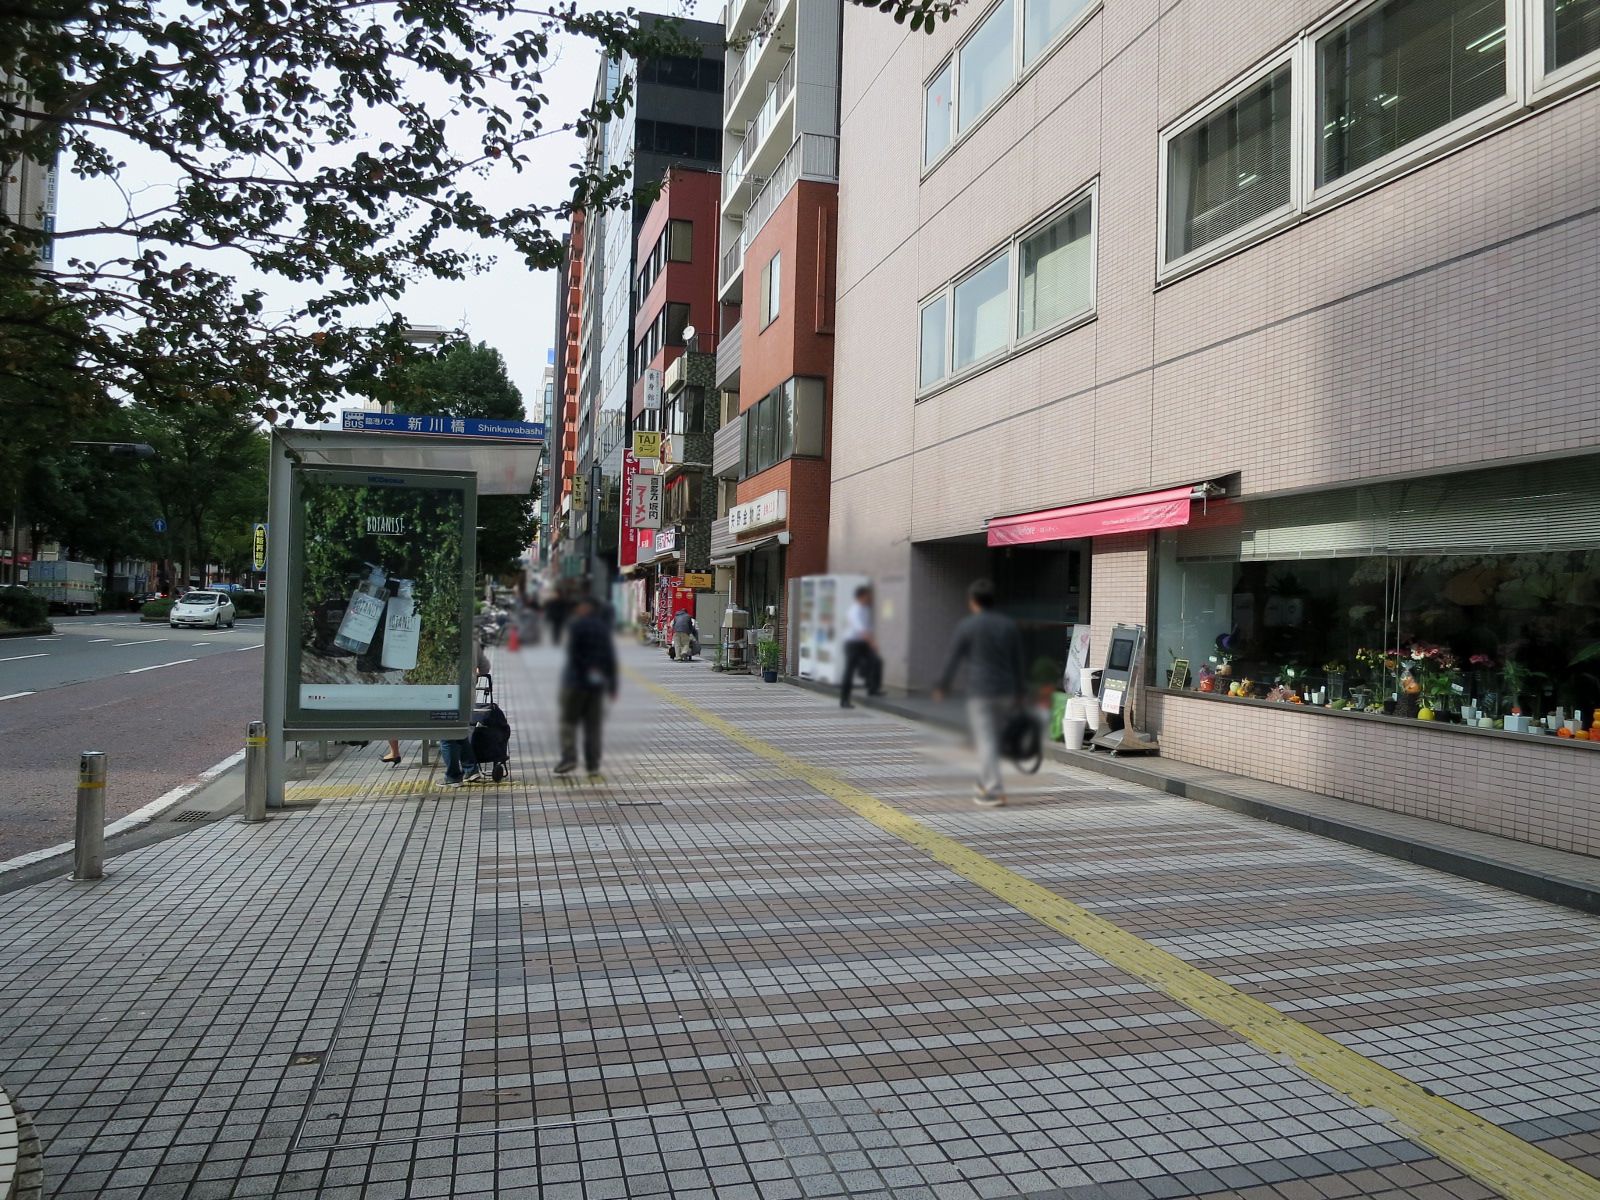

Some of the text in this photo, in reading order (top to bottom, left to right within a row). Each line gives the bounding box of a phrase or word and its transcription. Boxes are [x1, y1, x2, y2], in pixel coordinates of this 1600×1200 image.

[344, 420, 365, 429] BUS
[407, 416, 466, 434] 新川橋
[477, 423, 544, 436] Shinkawabashi
[638, 435, 656, 445] TAJ
[635, 485, 648, 525] ラーメン
[366, 515, 404, 533] BOTANIST
